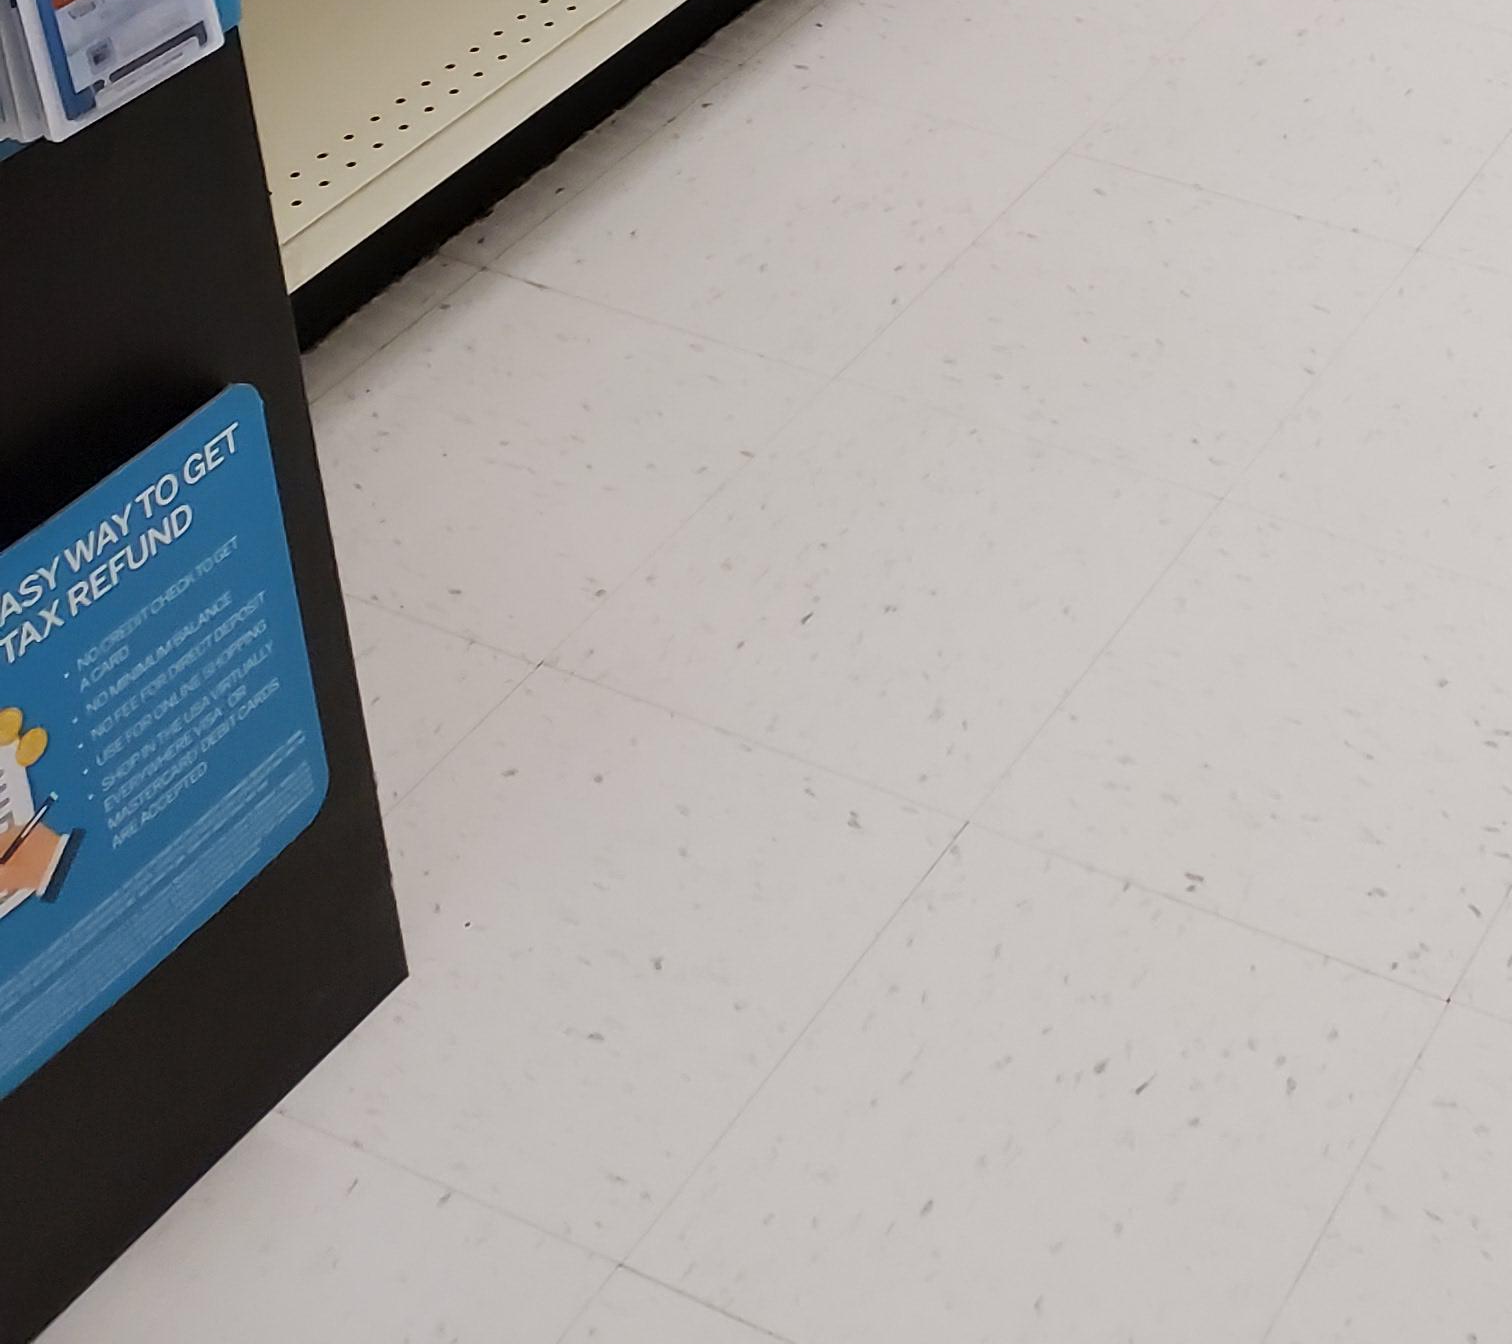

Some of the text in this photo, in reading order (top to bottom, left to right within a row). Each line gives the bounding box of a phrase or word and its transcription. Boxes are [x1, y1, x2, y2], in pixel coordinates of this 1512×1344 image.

[64, 503, 132, 573] WAY
[135, 473, 179, 519] TO
[183, 421, 239, 485] GET
[0, 504, 193, 664] TAX REFUND
[77, 647, 99, 671] NO
[213, 534, 238, 563] GET
[86, 690, 108, 714] NO
[173, 590, 232, 648] BALANCE
[80, 644, 129, 693] A CARD
[91, 589, 266, 740] NO FEE FOR DIRECT DEPOSIT
[96, 619, 267, 766] USE FOR ONLINE SHOPPING
[102, 751, 141, 792] SHOP
[156, 716, 183, 744] THE
[210, 639, 273, 700] VIRTUALLY
[200, 713, 236, 753] DEBIT
[237, 677, 280, 721] CARDS
[104, 727, 195, 813] EVERYWHERE
[112, 762, 208, 850] ARE ACCEPTED
